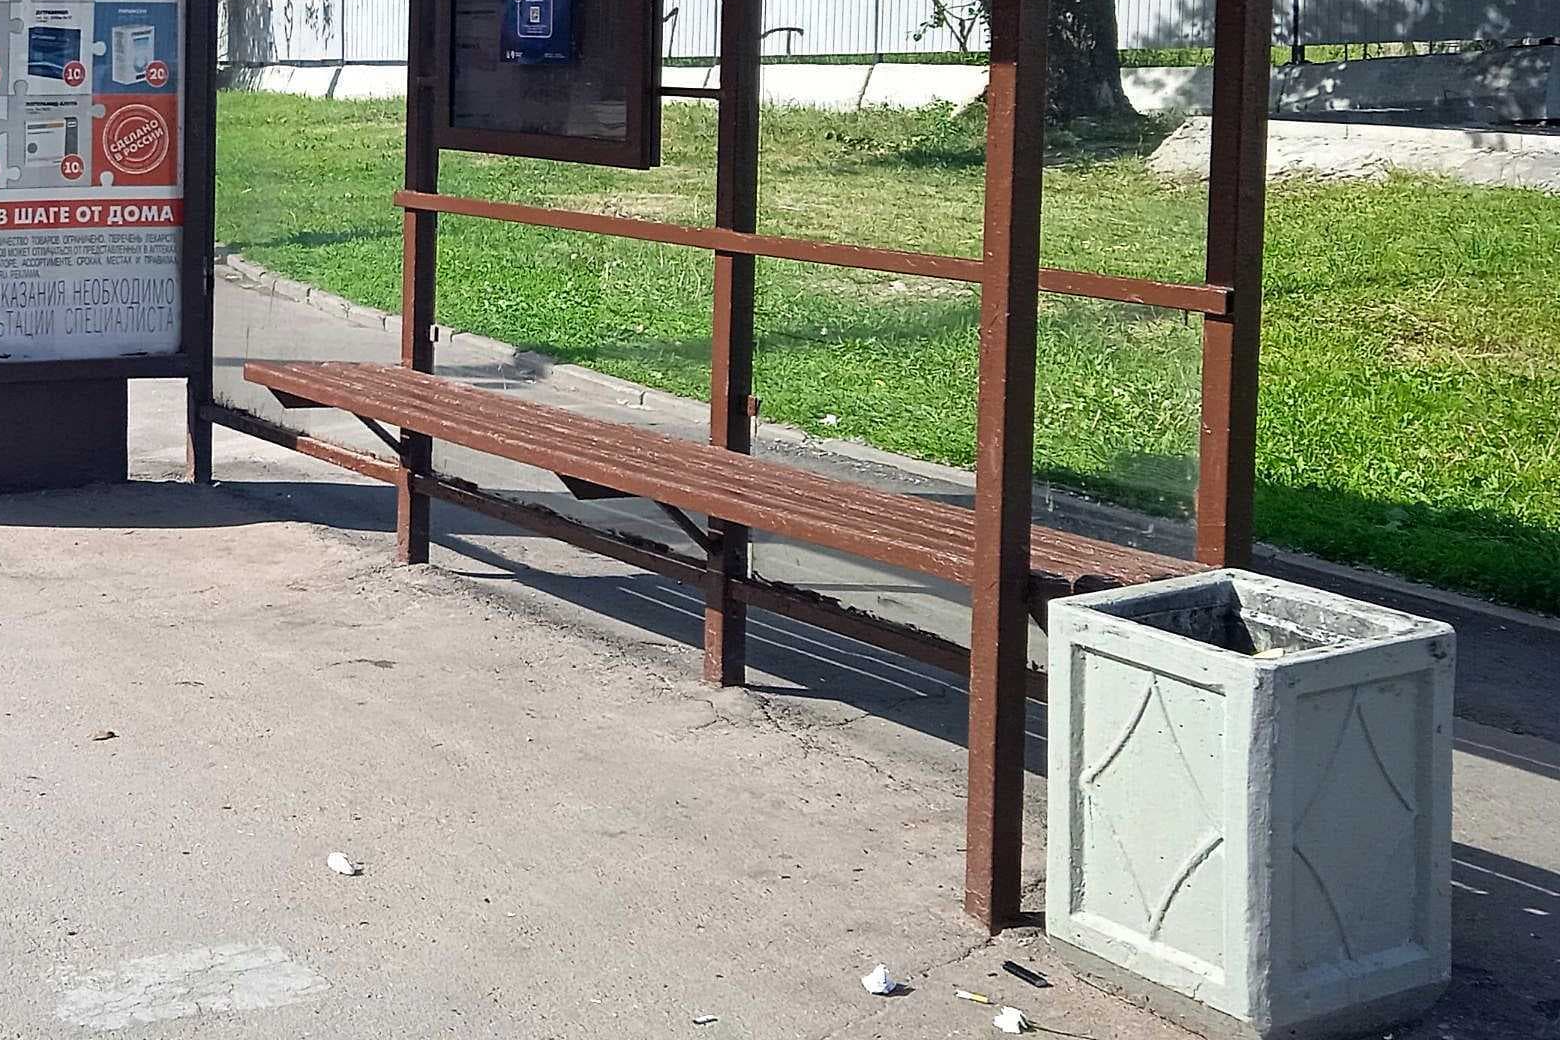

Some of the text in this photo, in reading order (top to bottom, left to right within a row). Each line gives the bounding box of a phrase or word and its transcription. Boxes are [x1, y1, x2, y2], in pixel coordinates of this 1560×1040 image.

[110, 119, 159, 153] СДЕЛАНО
[113, 128, 164, 162] В РОССИИ
[14, 206, 70, 225] ШАГЕ
[76, 206, 102, 223] ОТ
[107, 205, 174, 225] ДОМА
[73, 278, 175, 306] НЕОБХОДИМО
[64, 305, 174, 335] СПЕЦИАЛИСТА
